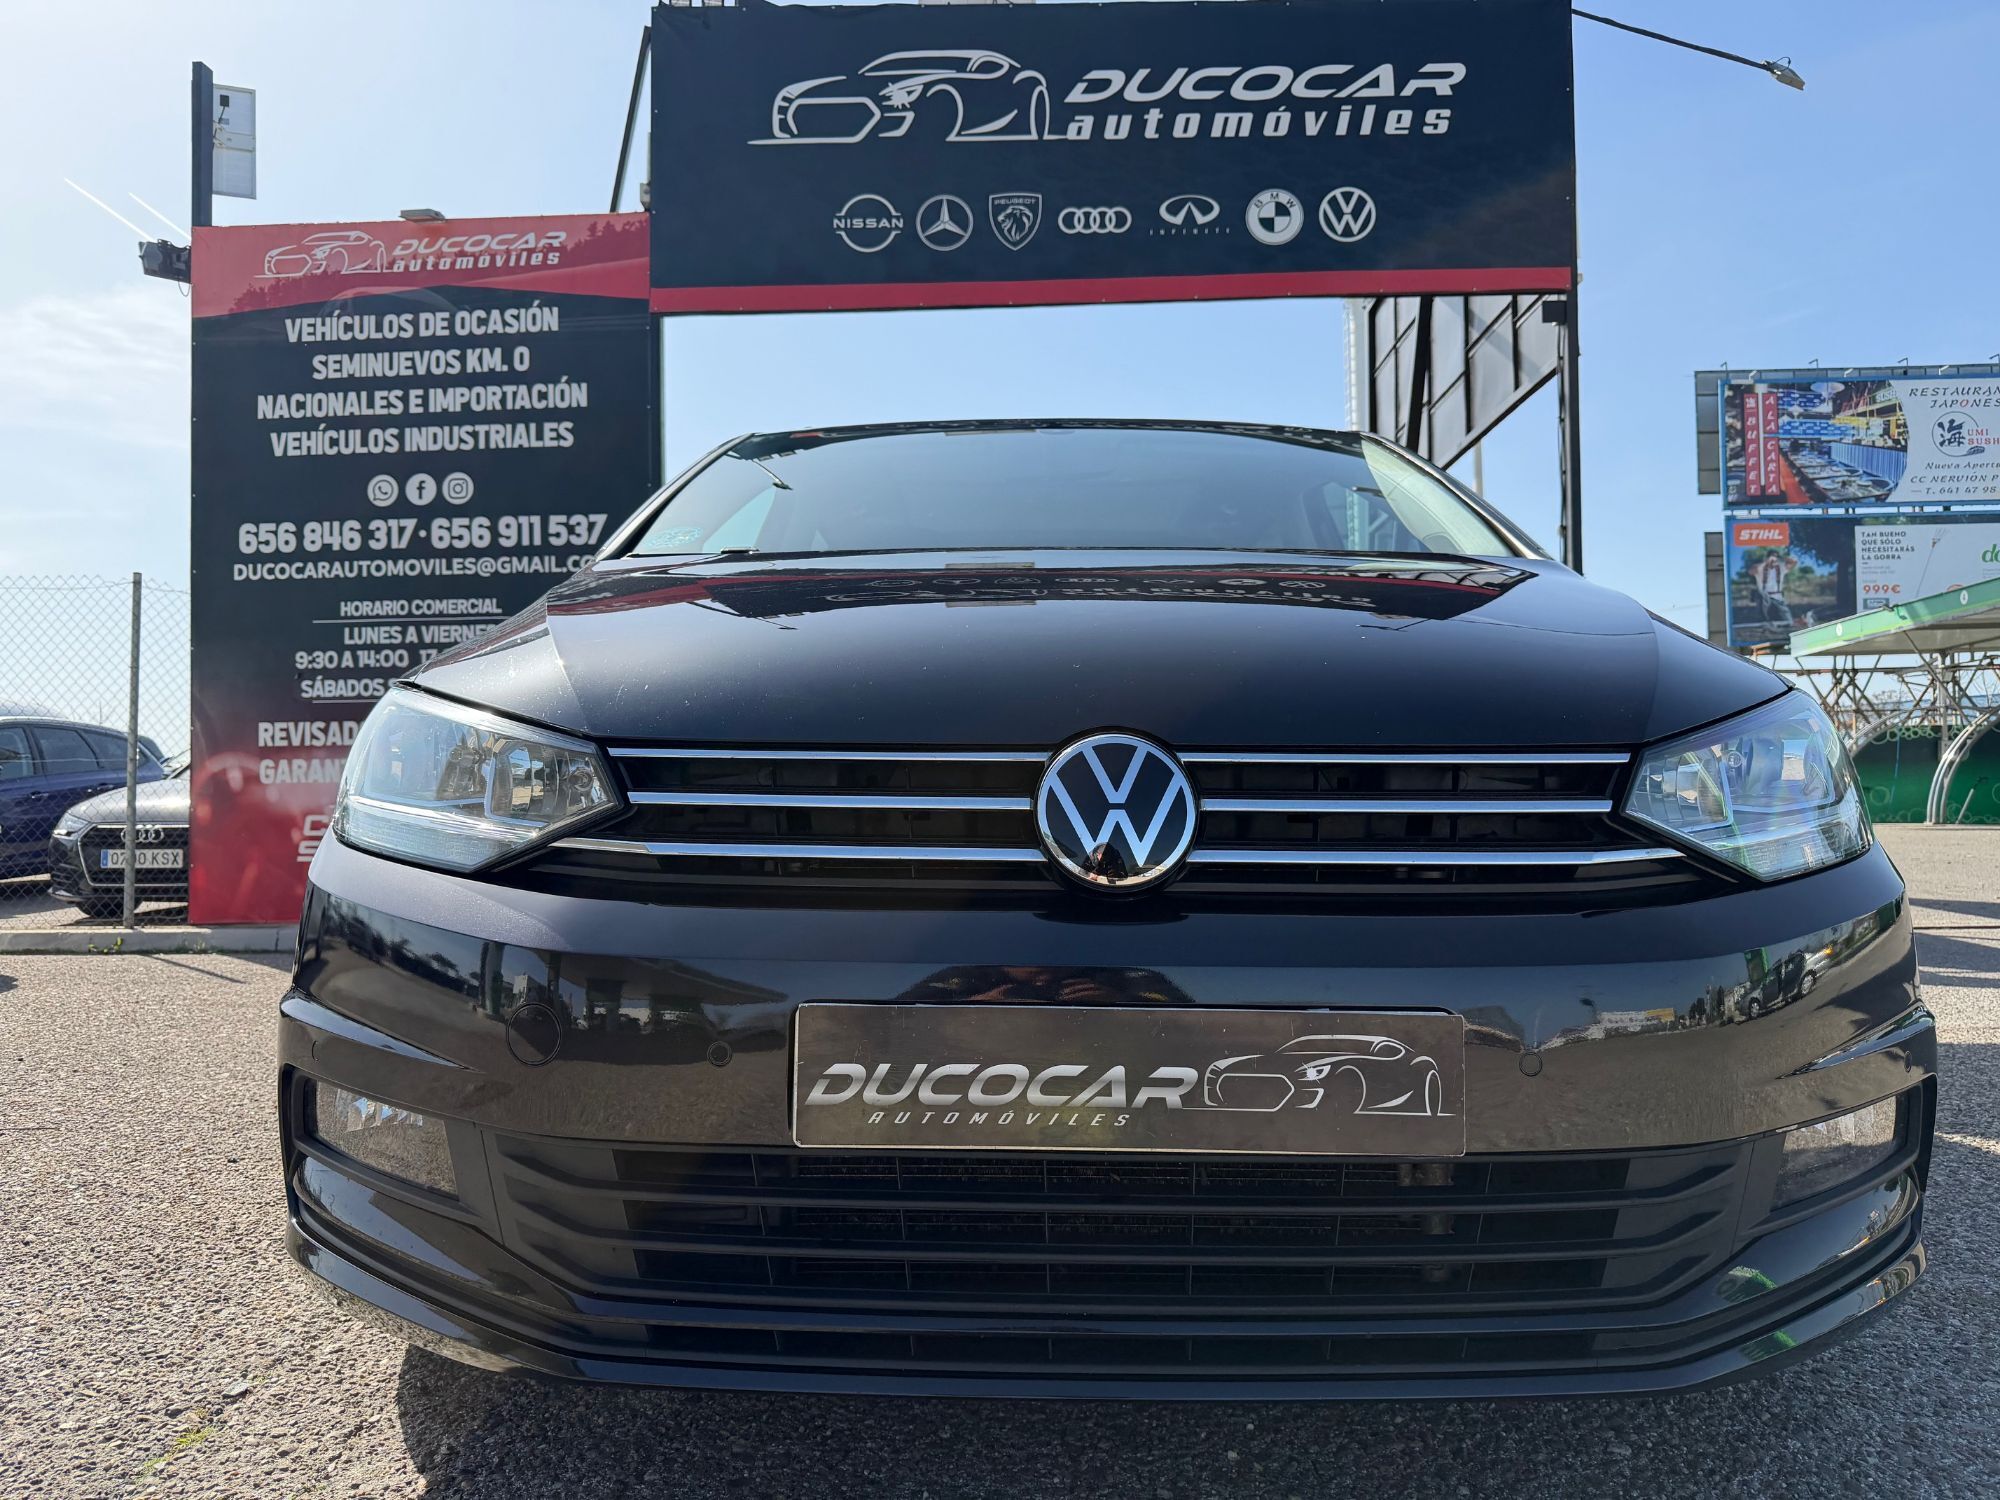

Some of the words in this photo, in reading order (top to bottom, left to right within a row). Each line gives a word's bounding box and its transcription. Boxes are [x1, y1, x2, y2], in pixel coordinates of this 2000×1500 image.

[1064, 62, 1467, 103] DUCOCAR
[1066, 104, 1452, 141] automóviles
[833, 217, 904, 229] NISSAN
[392, 231, 567, 255] DUCOCAR
[393, 250, 561, 272] automóviles
[285, 310, 414, 343] VEHÍCULOS
[418, 311, 450, 337] DE
[454, 300, 560, 336] OCASIÓN
[312, 349, 462, 380] SEMINUEVOS
[466, 348, 509, 374] KM.
[257, 388, 404, 420] NACIONALES
[408, 388, 425, 414] E
[428, 376, 588, 413] IMPORTACIÓN
[270, 423, 400, 457] VEHÍCULOS
[404, 421, 575, 453] INDUSTRIALES
[1967, 428, 1989, 436] UMI
[1910, 475, 1926, 484] CC
[238, 522, 297, 554] 656
[302, 521, 362, 552] 846
[497, 515, 542, 547] 911
[547, 513, 608, 546] 537
[1739, 528, 1784, 540] STIHL
[1863, 584, 1900, 594] 999€
[340, 600, 409, 617] HORARIO
[411, 598, 502, 616] COMERCIAL
[344, 626, 402, 645] LUNES
[405, 625, 419, 644] A
[295, 651, 338, 669] 9:30
[340, 651, 354, 669] A
[357, 649, 409, 668] 14:00
[301, 675, 385, 699] SÁBADOS
[258, 720, 364, 747] REVISAD
[259, 758, 346, 785] GARAN
[111, 852, 147, 865] 070
[151, 851, 180, 865] KSX
[804, 1062, 1199, 1109] DUCOCAR
[867, 1109, 1130, 1127] AUTOMÓVILES
